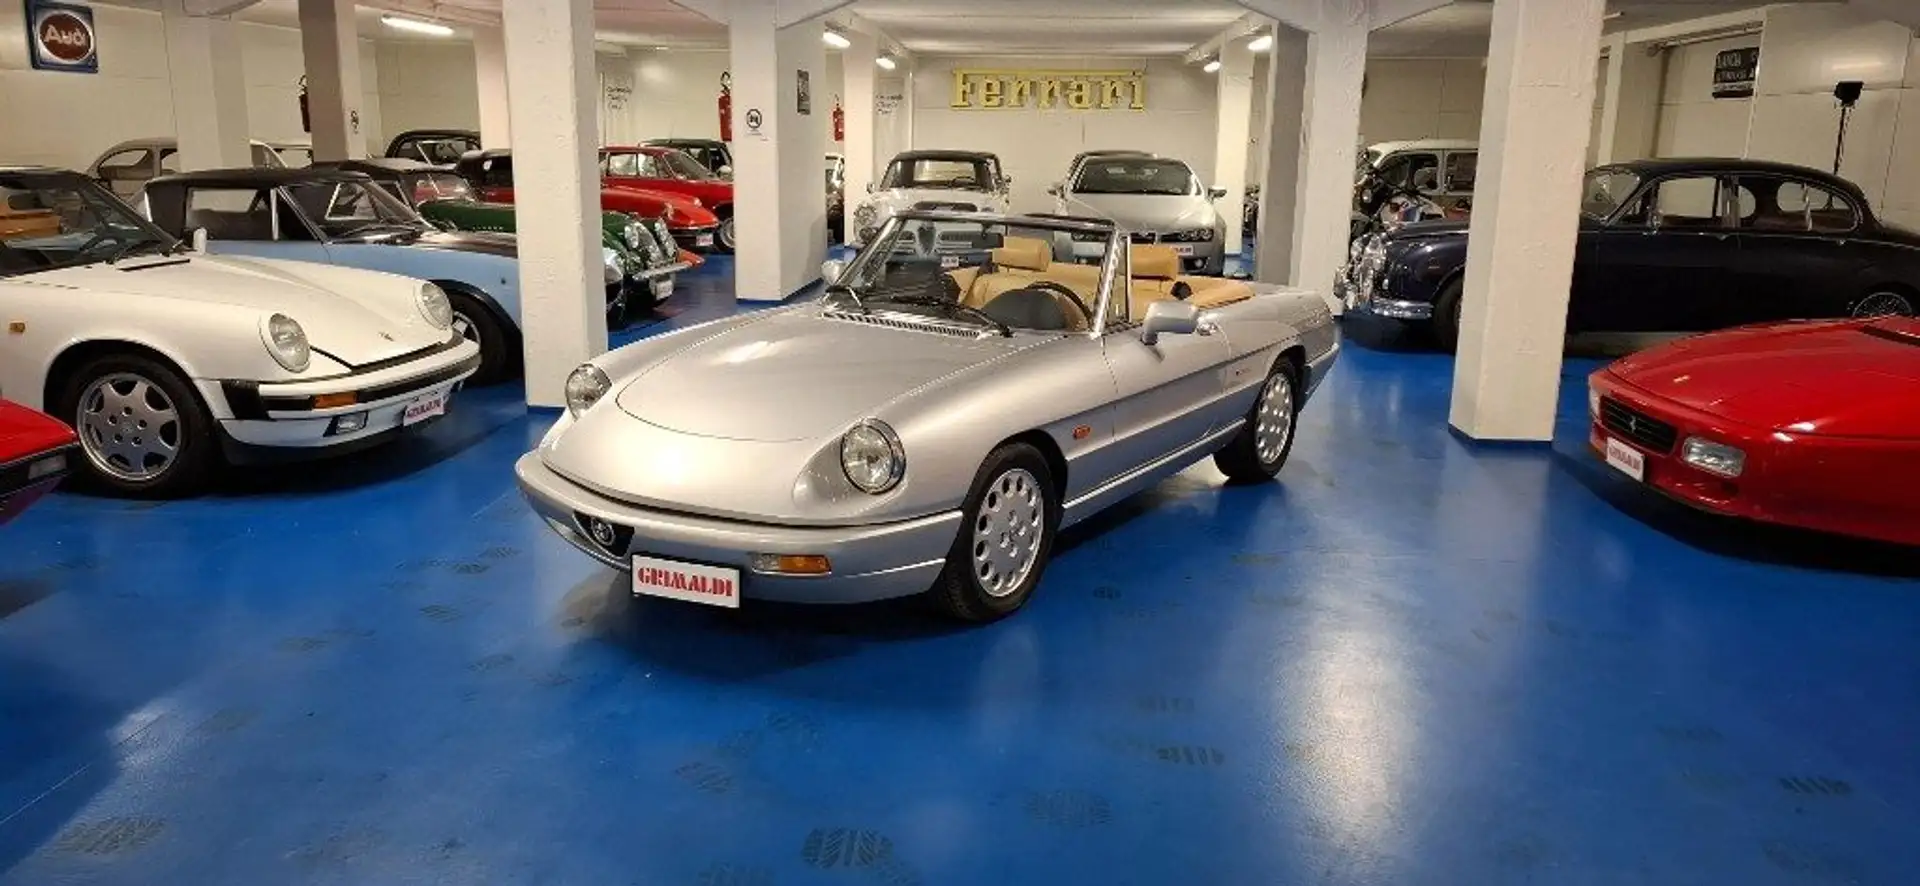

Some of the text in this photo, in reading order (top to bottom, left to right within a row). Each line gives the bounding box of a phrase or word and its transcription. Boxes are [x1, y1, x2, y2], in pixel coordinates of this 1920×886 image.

[43, 24, 87, 46] Audi
[951, 69, 1146, 111] Ferrari
[637, 566, 733, 597] GRIMALDI
